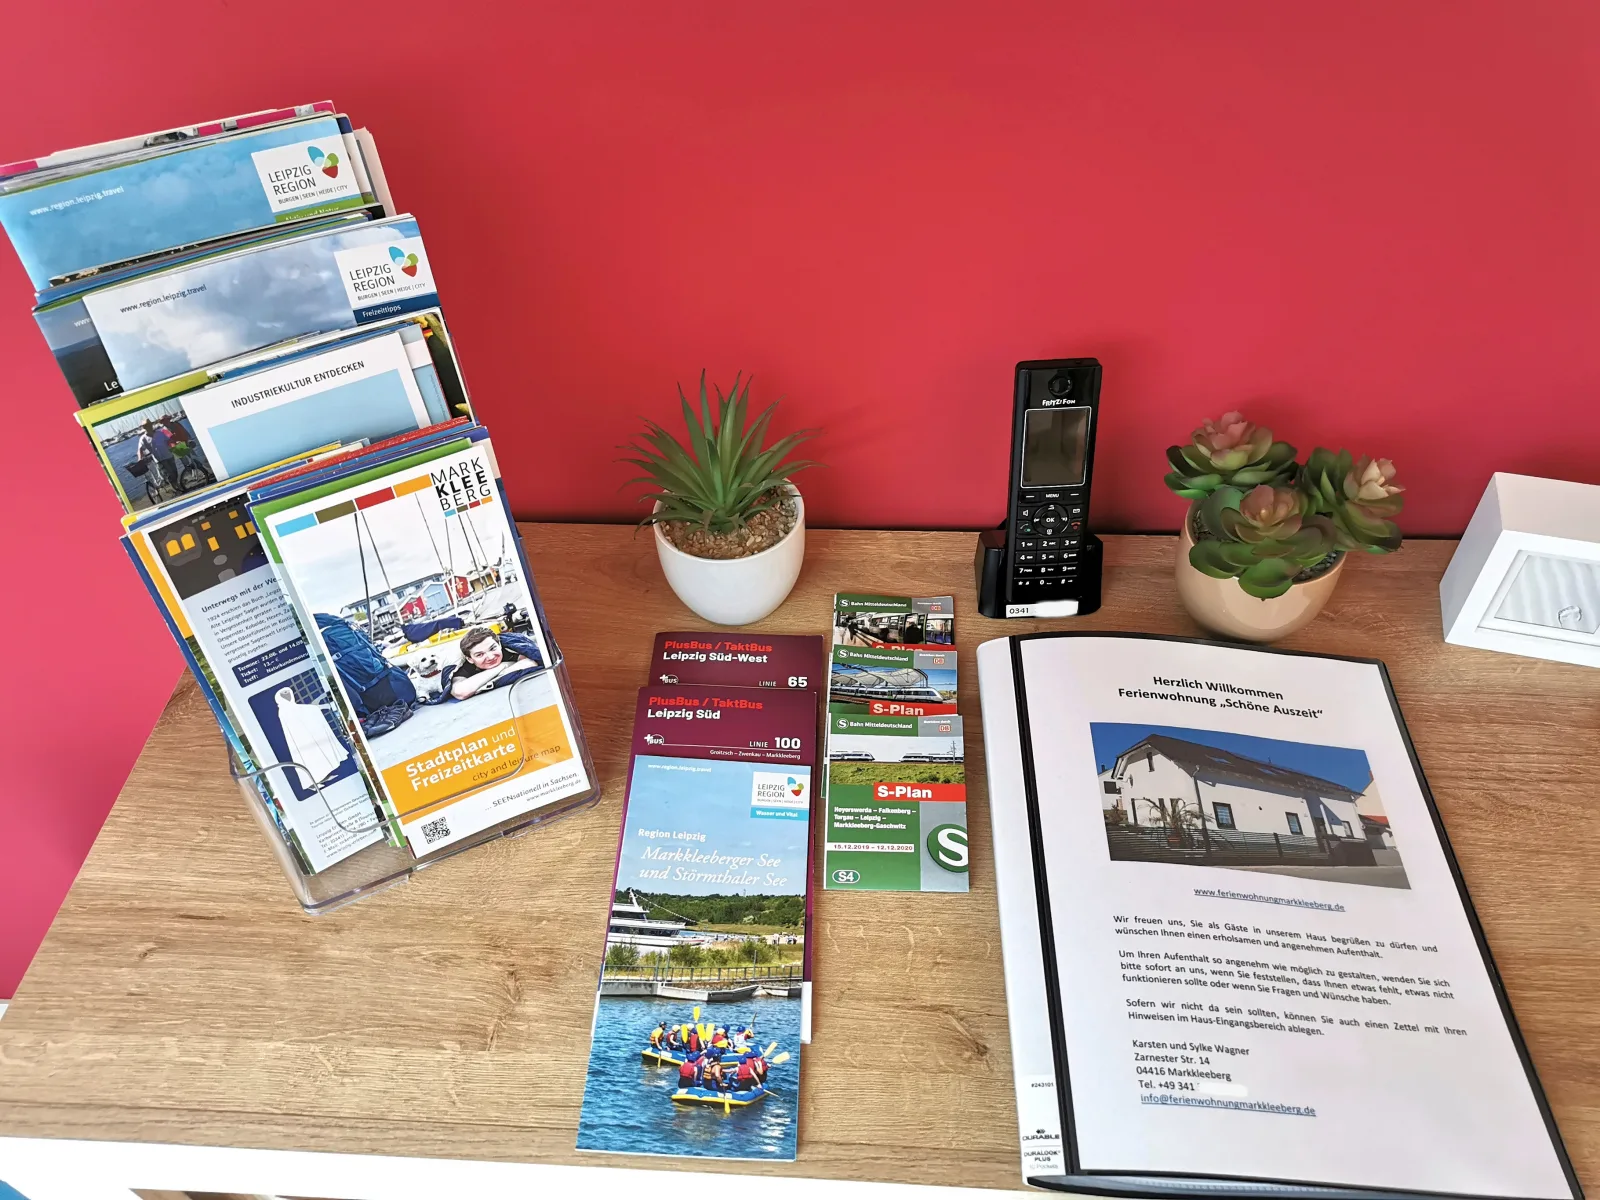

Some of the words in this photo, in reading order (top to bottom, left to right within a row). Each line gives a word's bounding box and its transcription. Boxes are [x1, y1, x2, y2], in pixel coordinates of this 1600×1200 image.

[269, 165, 312, 183] LEIPZIG
[273, 178, 316, 195] REGION
[278, 194, 299, 204] BURGEN
[302, 192, 315, 201] SEEN
[319, 188, 334, 197] HEIDE
[337, 185, 348, 194] CITY
[30, 186, 124, 216] www.region.leipzig.travel
[350, 264, 392, 280] LEIPZIG
[354, 276, 395, 292] REGION
[358, 291, 378, 300] BURGEN
[381, 289, 394, 297] SEEN
[397, 285, 411, 293] HEIDE
[120, 284, 207, 313] www.region.leipzig.travel
[363, 305, 401, 318] Freizeittipps
[231, 377, 312, 408] INDUSTRIEKULTUR
[314, 361, 365, 383] ENTDECKEN
[431, 457, 483, 485] MARK
[436, 470, 487, 498] KLEE
[440, 484, 490, 511] BERG
[201, 594, 238, 613] Unterwegs
[239, 588, 251, 596] mit
[252, 582, 264, 591] der
[664, 641, 712, 650] PlusBus
[724, 642, 772, 652] TaktBus
[663, 652, 706, 662] Leipzig
[709, 652, 767, 663] Süd-West
[788, 676, 807, 687] 65
[1153, 677, 1203, 689] Herzlich
[1206, 682, 1283, 700] Willkommen
[649, 697, 699, 706] PlusBus
[712, 698, 763, 709] TaktBus
[873, 704, 924, 715] S-Plan
[1118, 688, 1217, 707] Ferienwohnung
[1220, 698, 1270, 713] „Schöne
[1273, 705, 1323, 719] Auszeit“
[648, 709, 693, 720] Leipzig
[696, 710, 720, 719] Süd
[774, 737, 800, 749] 100
[406, 737, 488, 778] Stadtplan
[492, 727, 516, 743] und
[411, 742, 516, 792] Freizeitkarte
[472, 770, 489, 782] city
[490, 761, 512, 774] and
[541, 744, 561, 758] map
[542, 780, 549, 788] in
[877, 786, 932, 798] S-Plan
[638, 828, 670, 839] Region
[673, 831, 706, 842] Leipzig
[641, 846, 754, 869] Markkleeberger
[757, 854, 781, 868] See
[639, 866, 671, 880] und
[673, 867, 760, 885] Störmthaler
[763, 873, 787, 887] See
[838, 872, 854, 882] S4
[1194, 888, 1345, 912] www.ferienwohnungmarkkleeberg.de
[1115, 927, 1159, 936] wünschen
[1160, 929, 1185, 938] Ihnen
[1187, 932, 1211, 940] einen
[1213, 934, 1262, 946] erholsamen
[1264, 940, 1279, 948] und
[1281, 942, 1335, 954] angenehmen
[1336, 947, 1383, 958] Aufenthalt.
[1134, 916, 1163, 925] freuen
[1168, 919, 1186, 927] uns,
[1190, 920, 1203, 928] Sie
[1208, 922, 1220, 930] als
[1224, 923, 1248, 932] Gäste
[1253, 926, 1261, 934] in
[1266, 928, 1301, 939] unserem
[1306, 933, 1327, 941] Haus
[1331, 935, 1371, 946] begrüßen
[1390, 942, 1417, 951] dürfen
[1126, 999, 1156, 1008] Sofern
[1161, 1001, 1175, 1009] wir
[1181, 1002, 1203, 1011] nicht
[1209, 1004, 1219, 1012] da
[1225, 1006, 1242, 1015] sein
[1248, 1008, 1280, 1019] sollten,
[1283, 1011, 1316, 1023] können
[1321, 1015, 1334, 1024] Sie
[1339, 1017, 1360, 1027] auch
[1365, 1021, 1389, 1029] einen
[1394, 1022, 1419, 1032] Zettel
[1424, 1025, 1439, 1033] mit
[1444, 1027, 1467, 1036] Ihren
[1128, 1012, 1175, 1022] Hinweisen
[1177, 1014, 1189, 1023] im
[1191, 1015, 1286, 1032] Haus-Eingangsbereich
[1288, 1025, 1325, 1036] ablegen.
[1132, 1040, 1167, 1049] Karsten
[1170, 1042, 1187, 1050] und
[1189, 1042, 1213, 1053] Sylke
[1215, 1044, 1250, 1056] Wagner
[1134, 1053, 1178, 1063] Zarnester
[1180, 1054, 1196, 1064] Str.
[1199, 1056, 1210, 1065] 14
[1136, 1067, 1166, 1076] 04416
[1168, 1068, 1232, 1082] Markkleeberg
[1138, 1080, 1156, 1089] Tel.
[1158, 1081, 1175, 1090] +49
[1178, 1082, 1195, 1091] 341
[1141, 1094, 1316, 1116] info@ferienwohnungmarkkleeberg.de
